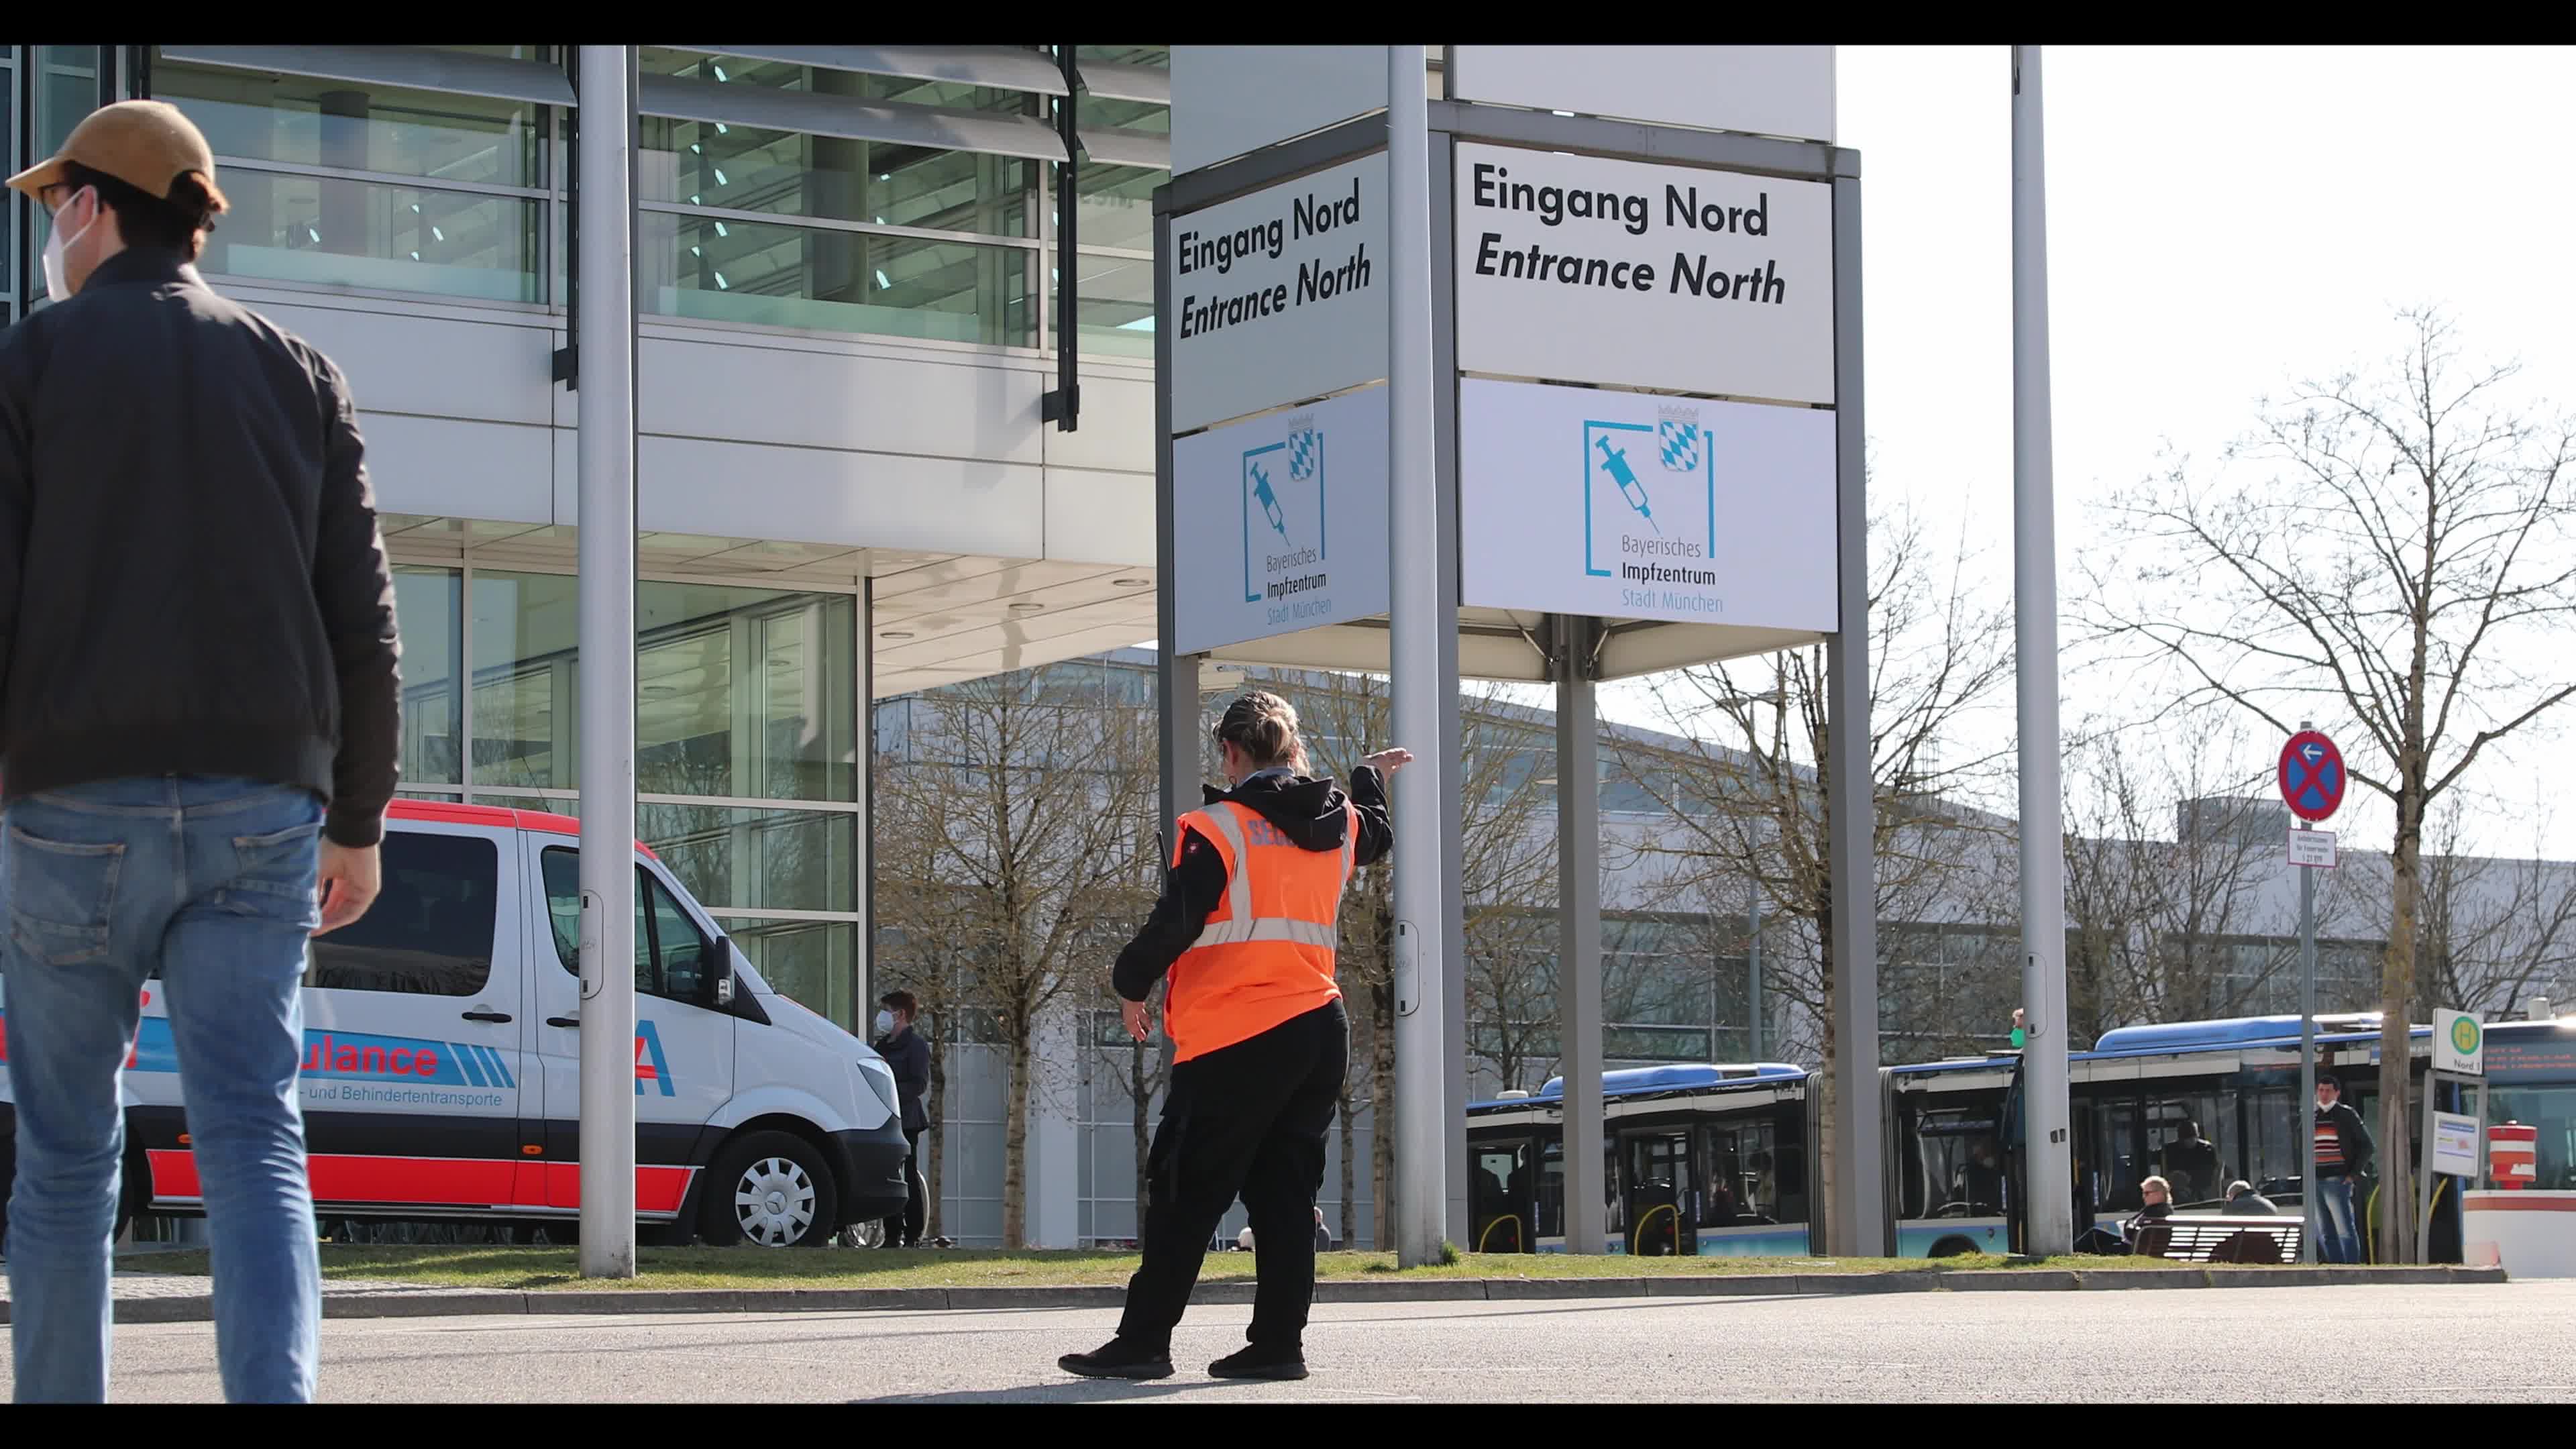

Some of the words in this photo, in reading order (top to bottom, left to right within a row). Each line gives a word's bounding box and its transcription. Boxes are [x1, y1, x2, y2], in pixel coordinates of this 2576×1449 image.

[1473, 163, 1649, 235] Eingang
[1665, 184, 1768, 237] Nord
[1179, 219, 1283, 275] Eingang
[1293, 176, 1360, 240] Nord
[1474, 232, 1655, 292] Entrance
[1668, 252, 1785, 305] North
[1179, 284, 1287, 339] Entrance
[1295, 243, 1371, 307] North
[1622, 534, 1701, 559] Bayerisches
[1267, 547, 1317, 575] Bayerisches
[1622, 561, 1716, 586] Impfzentrum
[1267, 573, 1327, 602] Impfzentrum
[1622, 588, 1656, 608] Stadt
[1662, 592, 1723, 613] München
[1267, 604, 1289, 626] Stadt
[1292, 598, 1332, 619] München
[301, 1034, 439, 1077] ulance
[2454, 1057, 2474, 1071] Nord
[309, 1087, 336, 1100] und
[341, 1085, 503, 1108] Behindertentransporte
